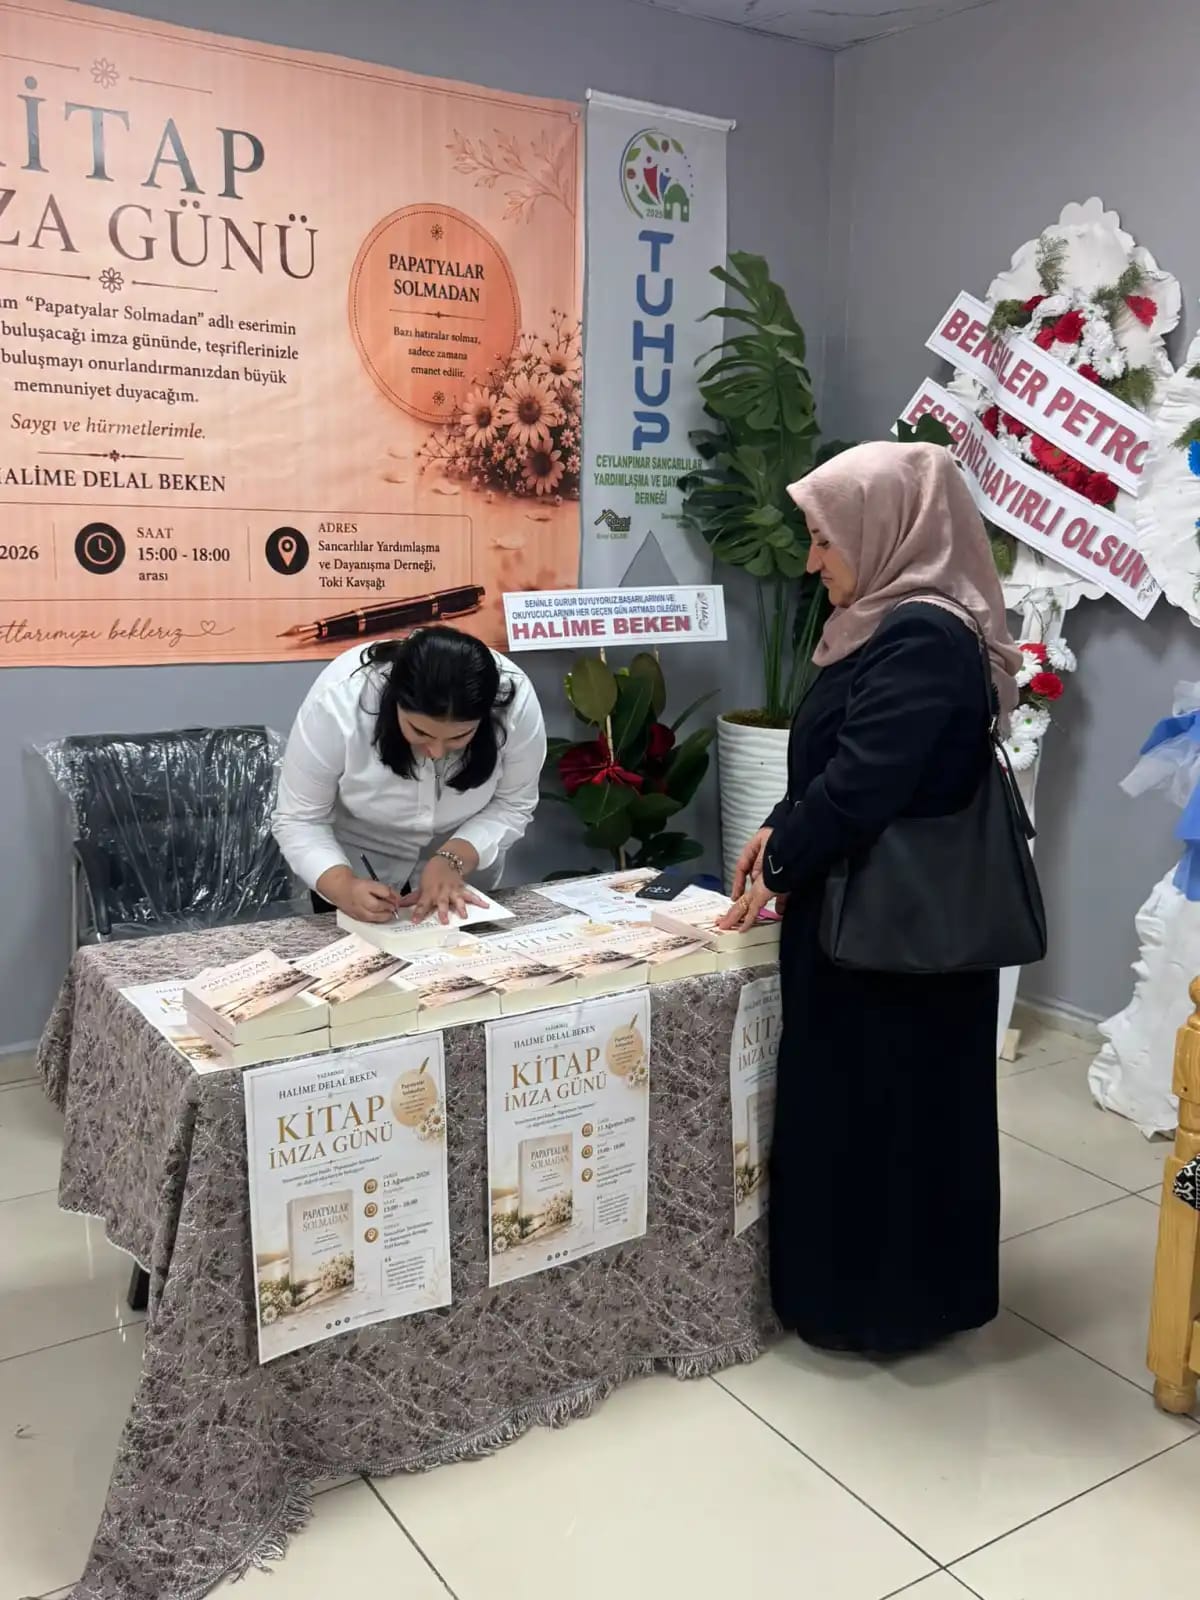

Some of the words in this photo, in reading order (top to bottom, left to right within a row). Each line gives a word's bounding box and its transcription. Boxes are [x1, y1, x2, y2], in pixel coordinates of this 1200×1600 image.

[0, 76, 265, 200] İTAP
[108, 199, 319, 279] GÜNÜ
[388, 253, 485, 280] PAPATYALAR
[393, 279, 480, 303] SOLMADAN
[26, 296, 119, 319] “Papatyalar
[124, 306, 204, 326] Solmadan”
[208, 314, 234, 330] adlı
[238, 319, 297, 336] eserimin
[1, 321, 87, 345] buluşacağı
[91, 328, 128, 345] imza
[132, 333, 202, 352] gününde,
[206, 340, 299, 361] teşriflerinizle
[414, 328, 449, 340] hatıralar
[408, 346, 435, 357] sadece
[437, 350, 468, 360] zamana
[1, 349, 83, 371] buluşmayı
[88, 358, 240, 381] onurlandırmanızdan
[244, 366, 287, 387] büyük
[411, 366, 440, 376] emanet
[442, 367, 465, 378] edilir.
[14, 380, 112, 399] memnuniyet
[116, 383, 199, 405] duyacağım.
[10, 413, 57, 435] Saygı
[63, 420, 80, 432] ve
[86, 416, 206, 440] hürmetlerimle.
[0, 465, 77, 487] ALİME
[83, 470, 153, 490] DELAL
[159, 473, 226, 492] BEKEN
[650, 475, 660, 487] VE
[635, 490, 667, 504] DERNEĞİ
[136, 527, 174, 539] SAAT
[318, 523, 358, 534] ADRES
[979, 458, 1065, 537] HAYIRLI
[1061, 517, 1148, 589] OLSUN
[0, 545, 39, 560] 2026
[138, 547, 177, 561] 15:00
[192, 548, 230, 562] 18:00
[318, 540, 373, 552] Sancarlılar
[377, 541, 440, 555] Yardımlaşma
[139, 571, 168, 581] arası
[319, 561, 331, 570] ve
[334, 559, 390, 573] Dayanışma
[394, 559, 436, 573] Derneği,
[319, 576, 343, 587] Toki
[346, 577, 386, 591] Kavşağı
[525, 598, 553, 608] SENİNLE
[554, 597, 577, 607] GURUR
[666, 594, 675, 602] VE
[576, 608, 590, 616] HER
[591, 606, 612, 616] GEÇEN
[614, 605, 627, 614] GÜN
[512, 617, 606, 640] HALİME
[613, 615, 692, 634] BEKEN
[513, 1034, 544, 1048] HALİME
[546, 1030, 570, 1042] DELAL
[572, 1025, 596, 1037] BEKEN
[511, 1047, 600, 1089] KİTAP
[279, 1084, 316, 1099] HALİME
[318, 1079, 347, 1092] DELAL
[349, 1070, 378, 1084] BEKEN
[504, 1088, 551, 1112] İMZA
[557, 1071, 607, 1099] GÜNÜ
[276, 1094, 385, 1145] KİTAP
[268, 1140, 327, 1170] İMZA
[332, 1121, 393, 1153] GÜNÜ
